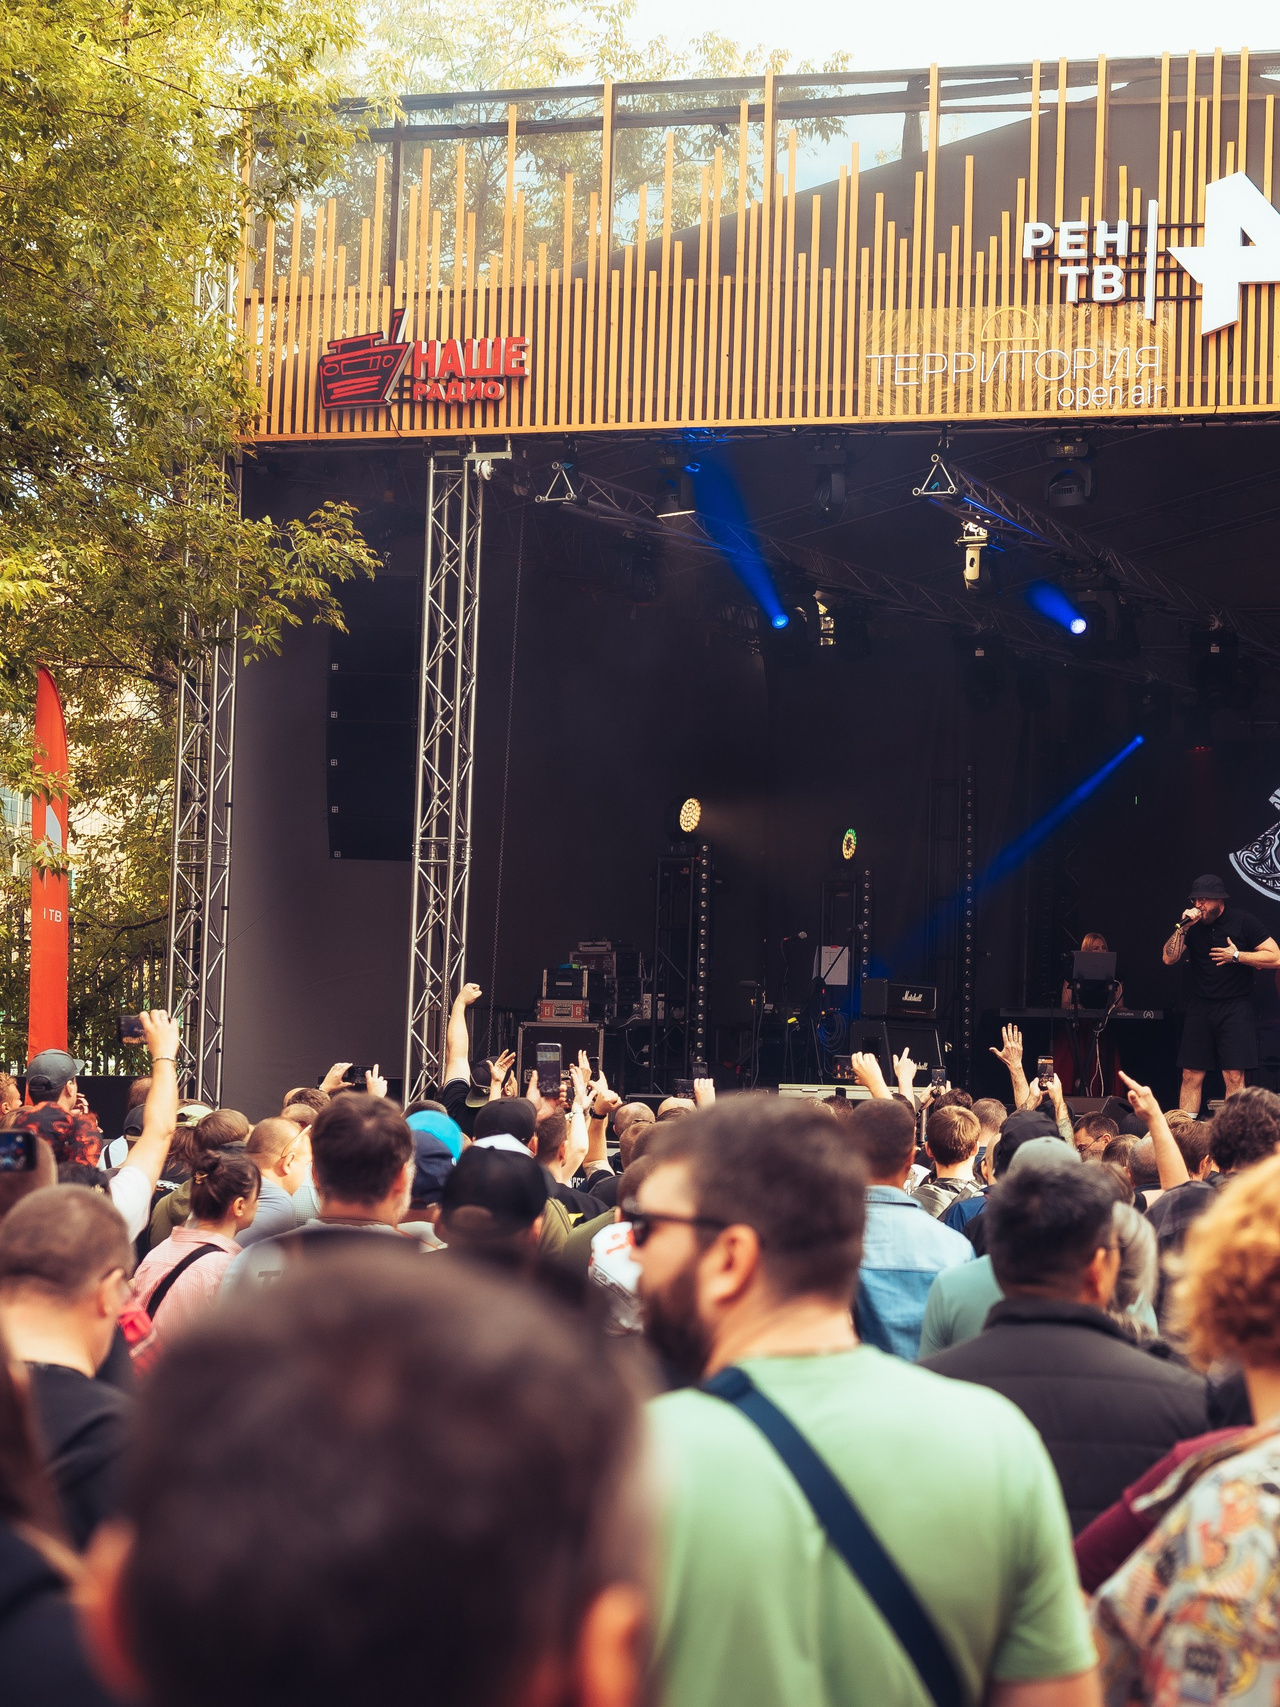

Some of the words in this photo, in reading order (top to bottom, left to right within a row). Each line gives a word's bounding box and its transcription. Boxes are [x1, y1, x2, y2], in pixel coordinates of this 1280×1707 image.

[1023, 220, 1129, 260] РЕН
[1058, 265, 1124, 303] ТВ
[413, 336, 530, 380] НАШЕ
[865, 346, 1161, 386] ТЕРРИТОРИЯ
[413, 381, 504, 404] РАДИО
[1057, 383, 1123, 412] open
[1131, 378, 1167, 406] air
